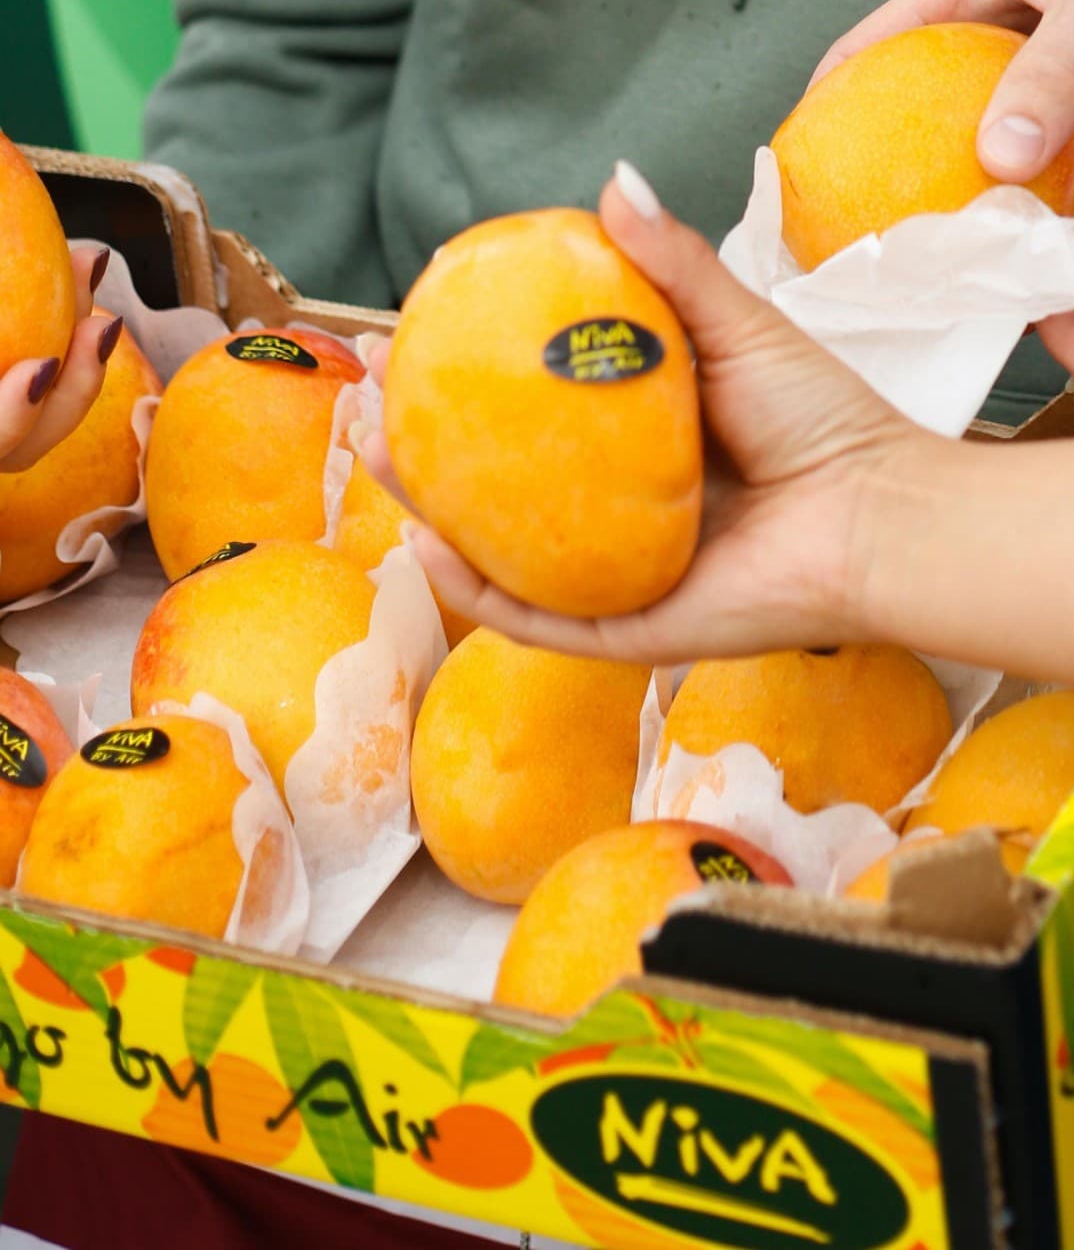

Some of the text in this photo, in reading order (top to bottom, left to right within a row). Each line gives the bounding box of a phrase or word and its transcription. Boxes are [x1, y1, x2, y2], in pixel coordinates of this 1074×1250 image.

[106, 1006, 220, 1143] by
[265, 1059, 441, 1162] Air
[600, 1092, 837, 1205] NiVA
